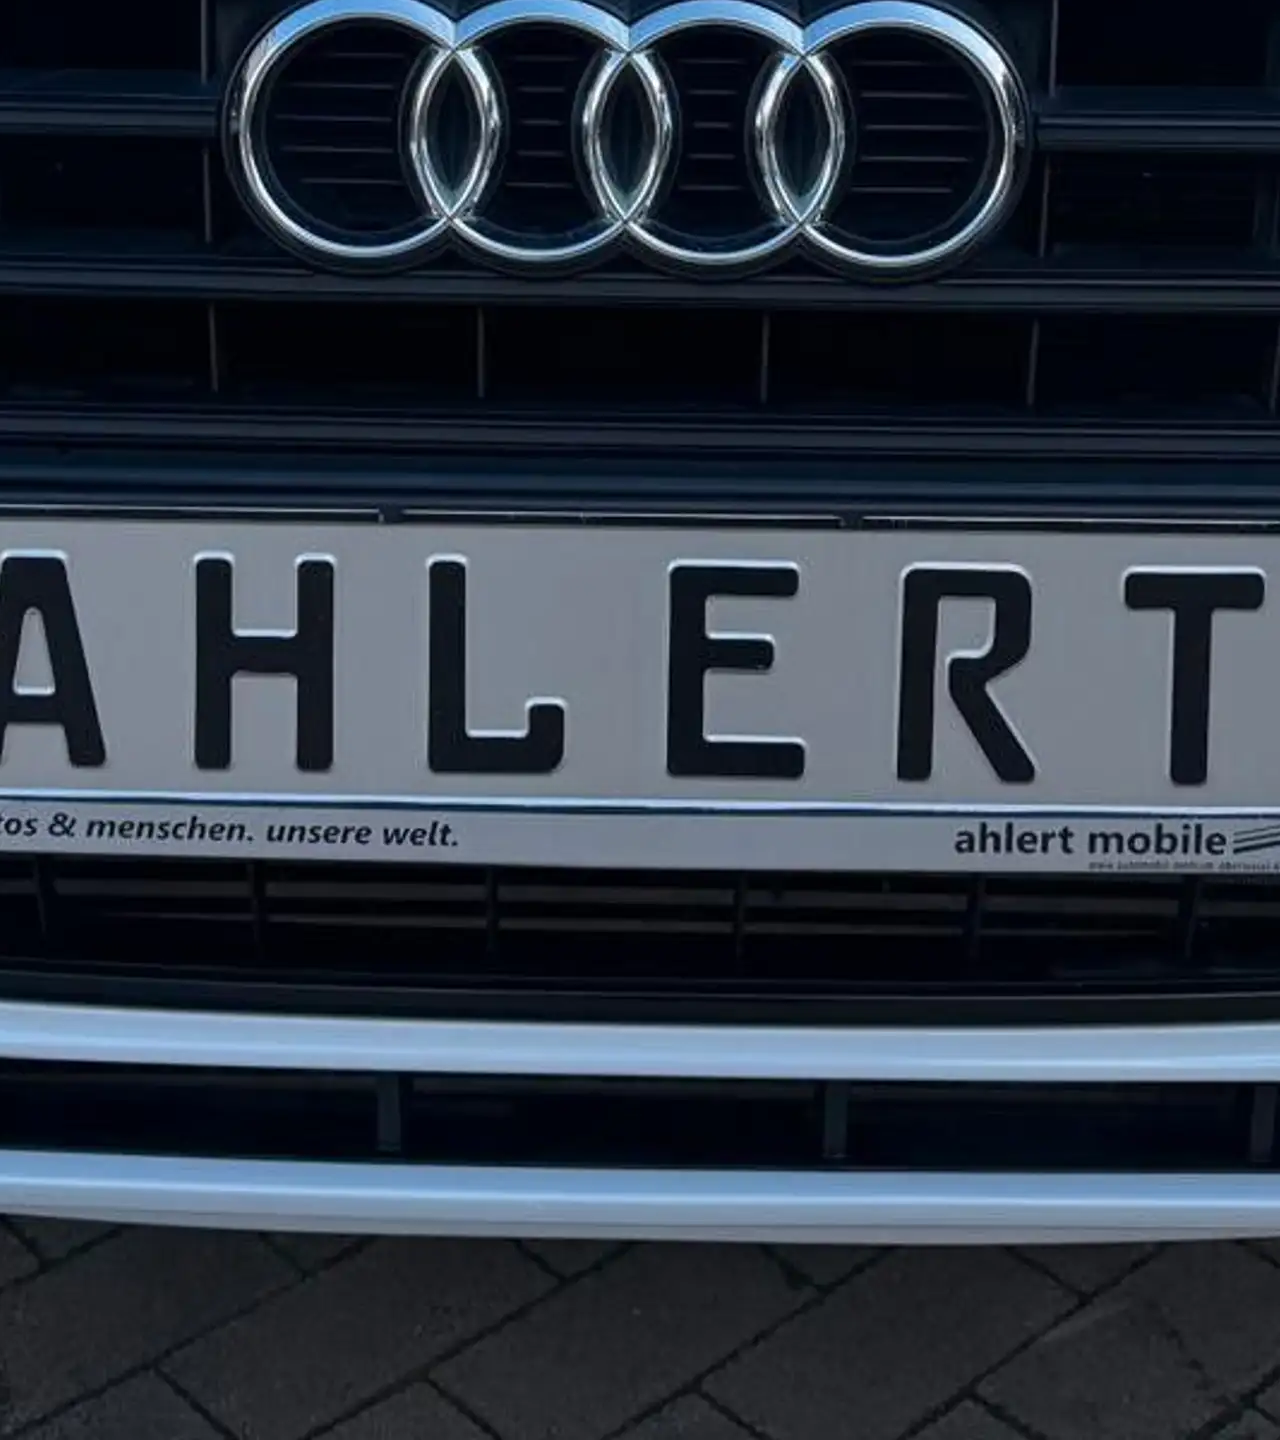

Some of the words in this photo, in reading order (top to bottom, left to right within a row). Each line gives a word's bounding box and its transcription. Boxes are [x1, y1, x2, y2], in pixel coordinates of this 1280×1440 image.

[47, 812, 77, 837] &
[86, 815, 255, 842] menschen.
[266, 825, 373, 845] unsere
[383, 820, 459, 847] welt.
[954, 821, 1075, 855] ahlert
[1088, 822, 1227, 856] mobile
